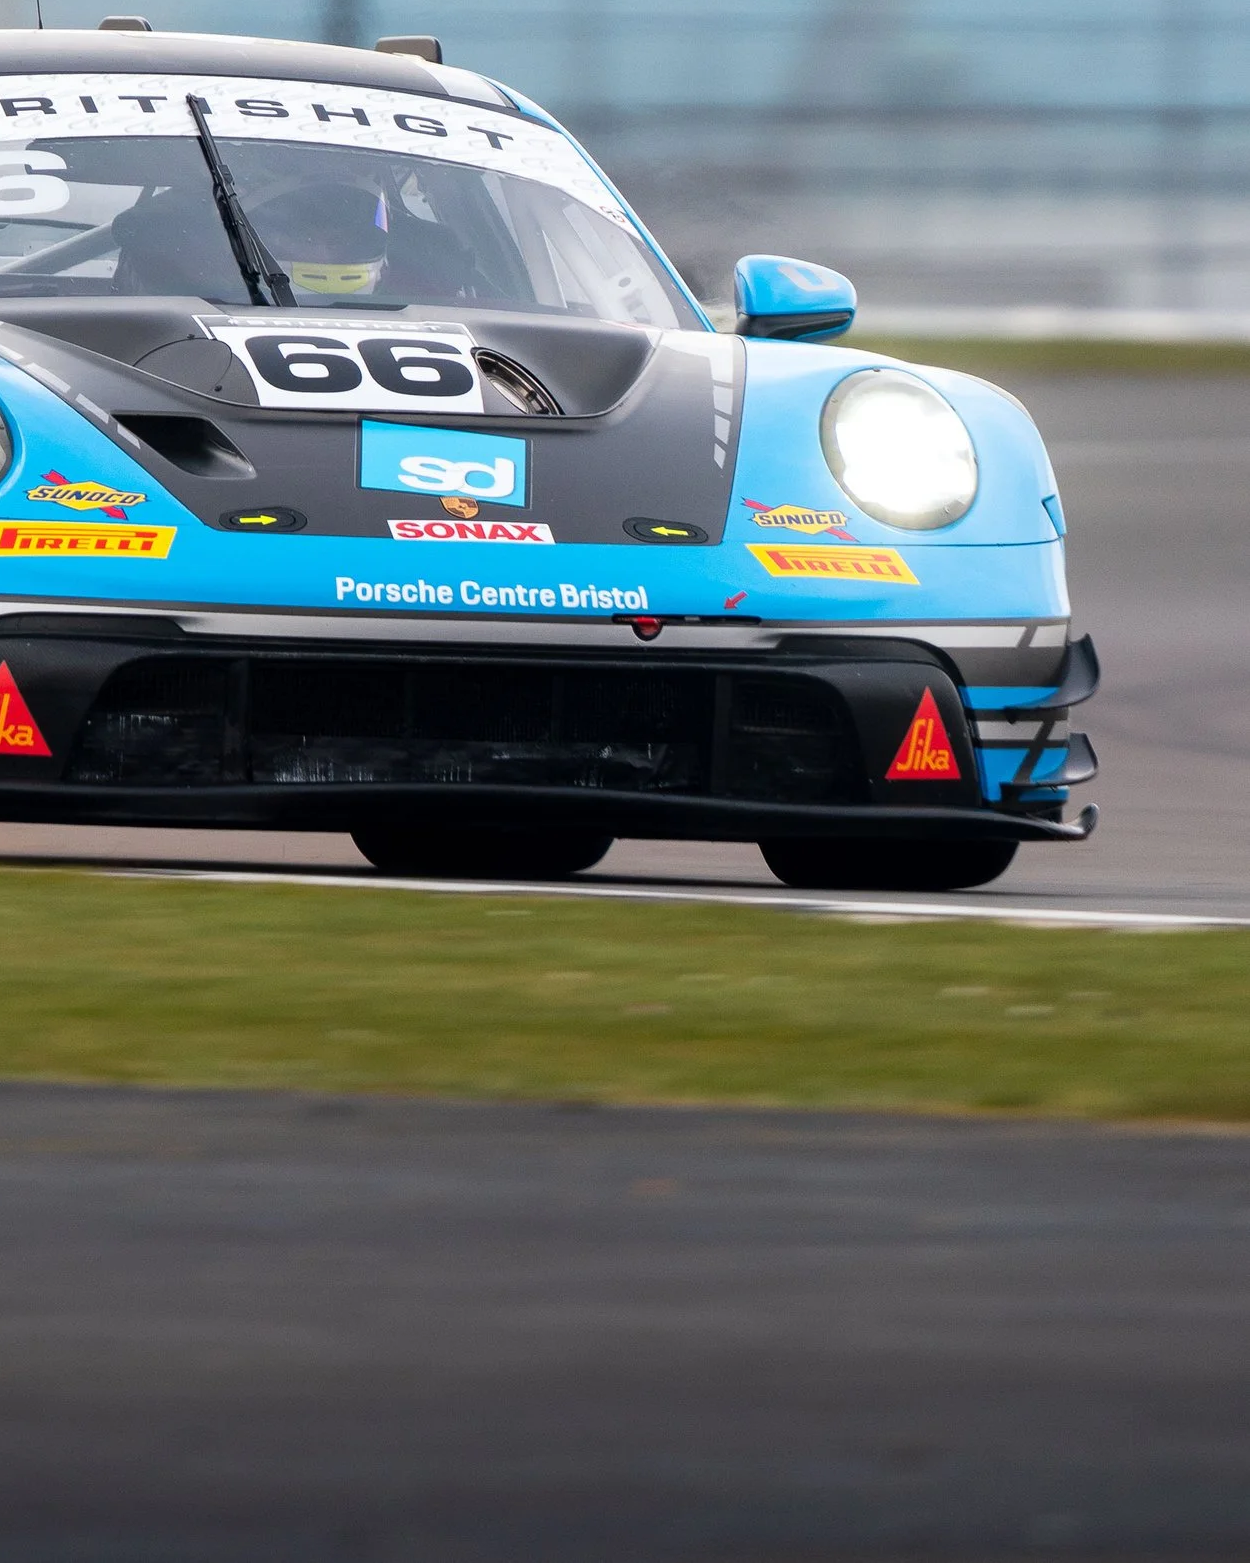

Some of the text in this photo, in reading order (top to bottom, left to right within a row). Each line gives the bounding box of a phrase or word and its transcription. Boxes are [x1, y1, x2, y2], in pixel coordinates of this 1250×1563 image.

[244, 335, 474, 397] 66
[397, 455, 515, 498] sd
[33, 488, 140, 505] SUNOCO
[395, 522, 545, 542] SONAX
[758, 513, 843, 526] SUNOCO
[765, 550, 903, 577] PIRELLI
[335, 576, 649, 610] Porsche Centre Bristol
[896, 718, 950, 771] Sika
